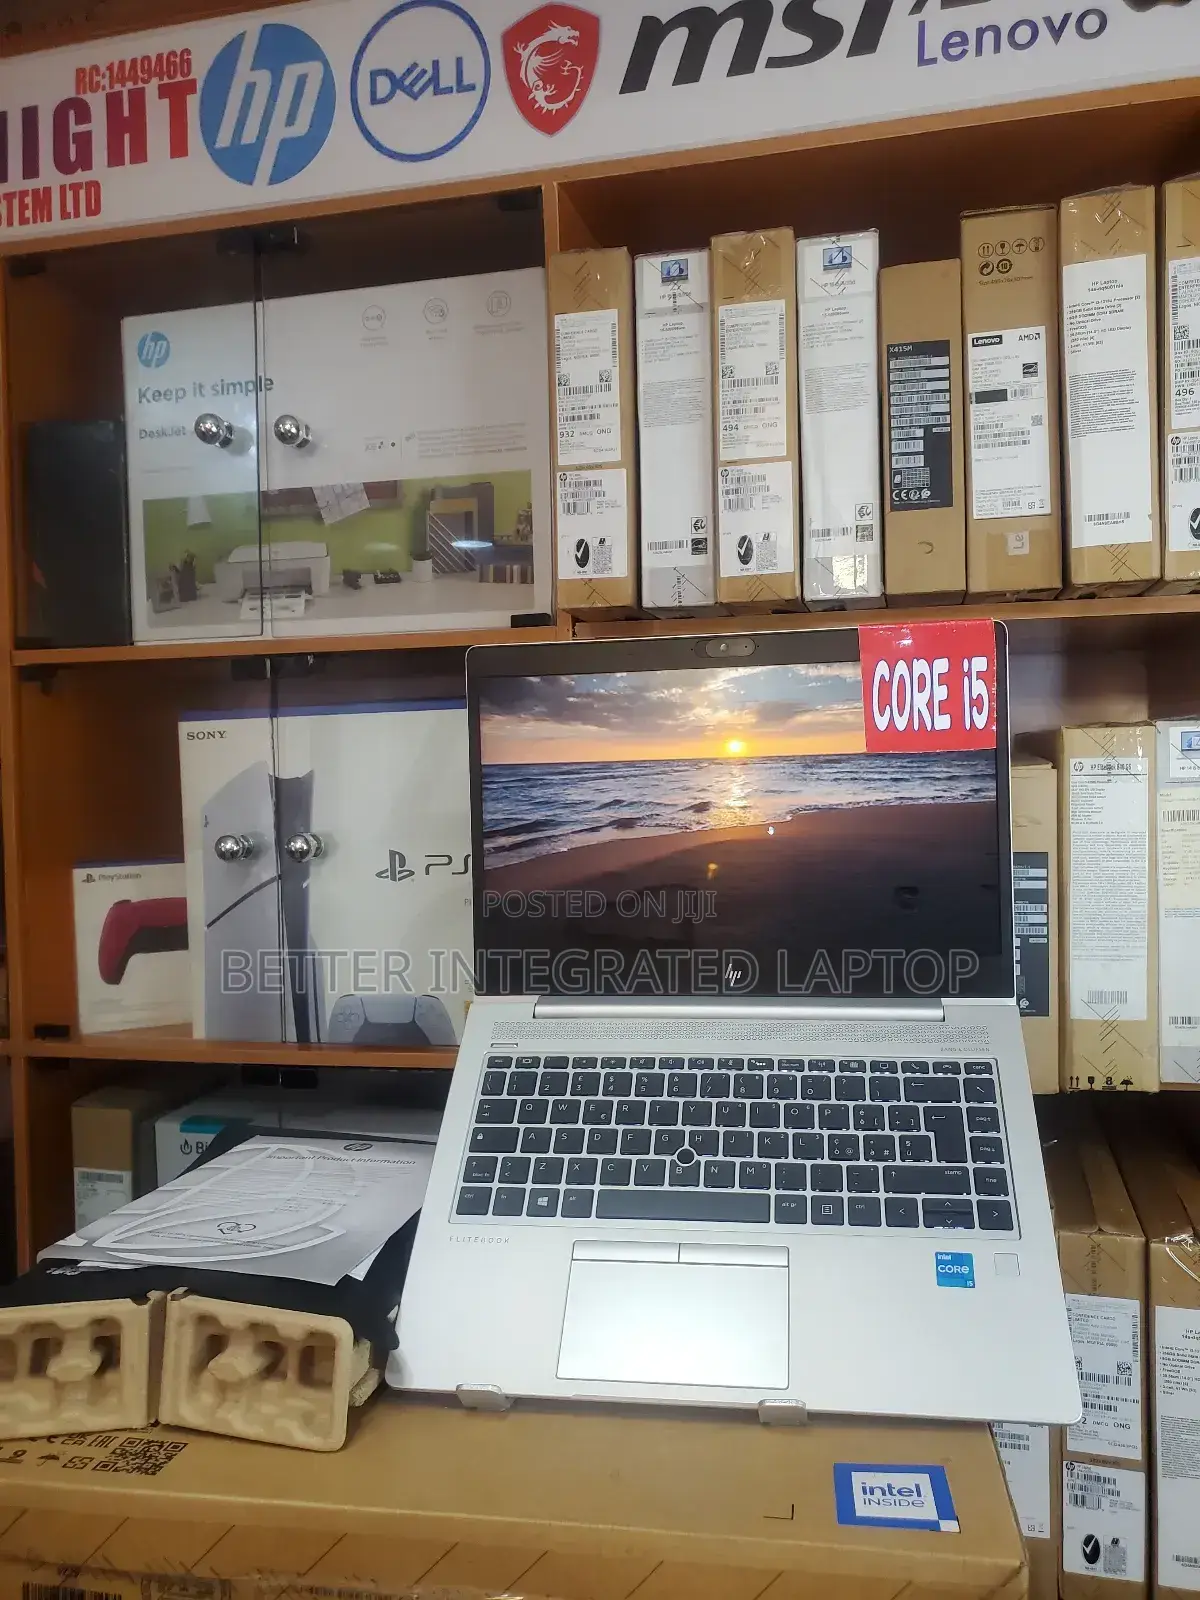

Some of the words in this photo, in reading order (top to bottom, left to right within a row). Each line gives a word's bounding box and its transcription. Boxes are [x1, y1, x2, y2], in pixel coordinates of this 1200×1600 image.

[917, 8, 1108, 67] Lenovo
[75, 48, 192, 94] RC:1449466
[370, 56, 476, 106] DELL
[59, 180, 101, 220] LTD
[973, 336, 1001, 345] Lenovo
[1018, 333, 1034, 342] AMD
[138, 386, 186, 404] Keep
[192, 381, 206, 398] it
[210, 375, 274, 399] simple
[1175, 388, 1195, 397] 496
[138, 427, 187, 440] DeskJet
[559, 430, 575, 438] 932
[722, 424, 739, 432] 494
[872, 658, 952, 731] CORE
[962, 656, 989, 731] i5
[186, 731, 227, 741] SONY
[98, 872, 142, 882] PlayStation
[861, 1481, 923, 1498] intel
